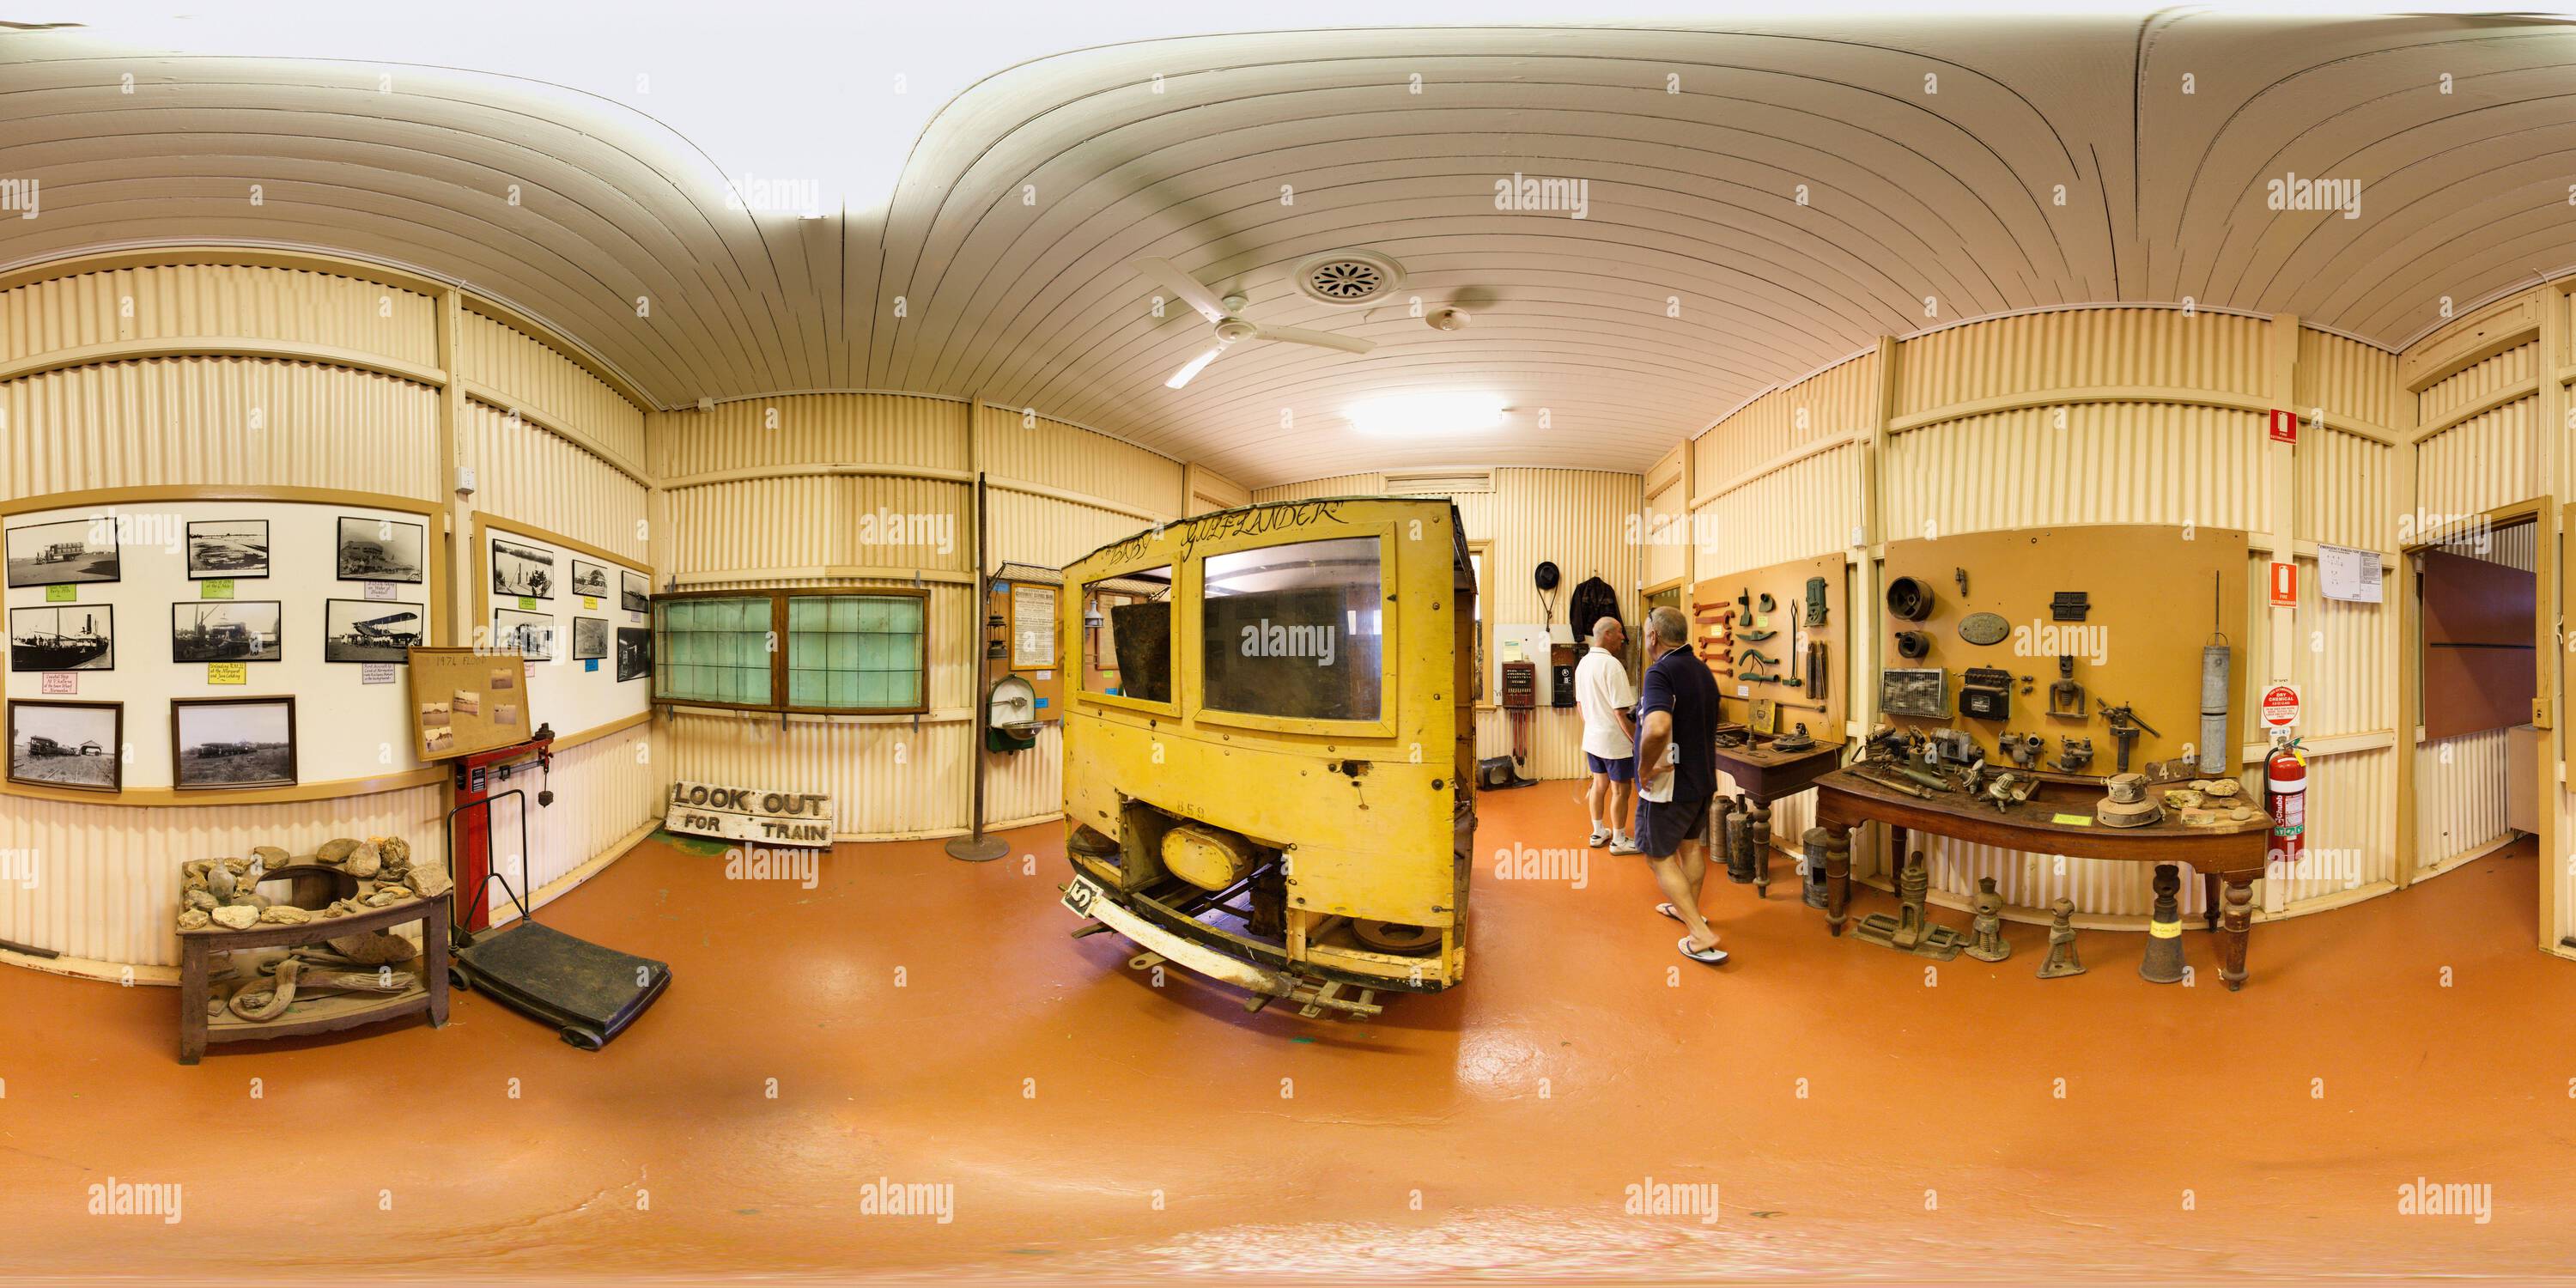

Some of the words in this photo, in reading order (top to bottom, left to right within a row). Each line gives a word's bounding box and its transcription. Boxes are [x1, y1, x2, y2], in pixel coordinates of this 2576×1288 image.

[2159, 763, 2170, 781] 4
[674, 781, 750, 811] LOOK
[763, 793, 829, 817] OUT
[684, 813, 720, 832] FOR
[761, 822, 828, 841] TRAIN
[1070, 883, 1091, 908] 5
